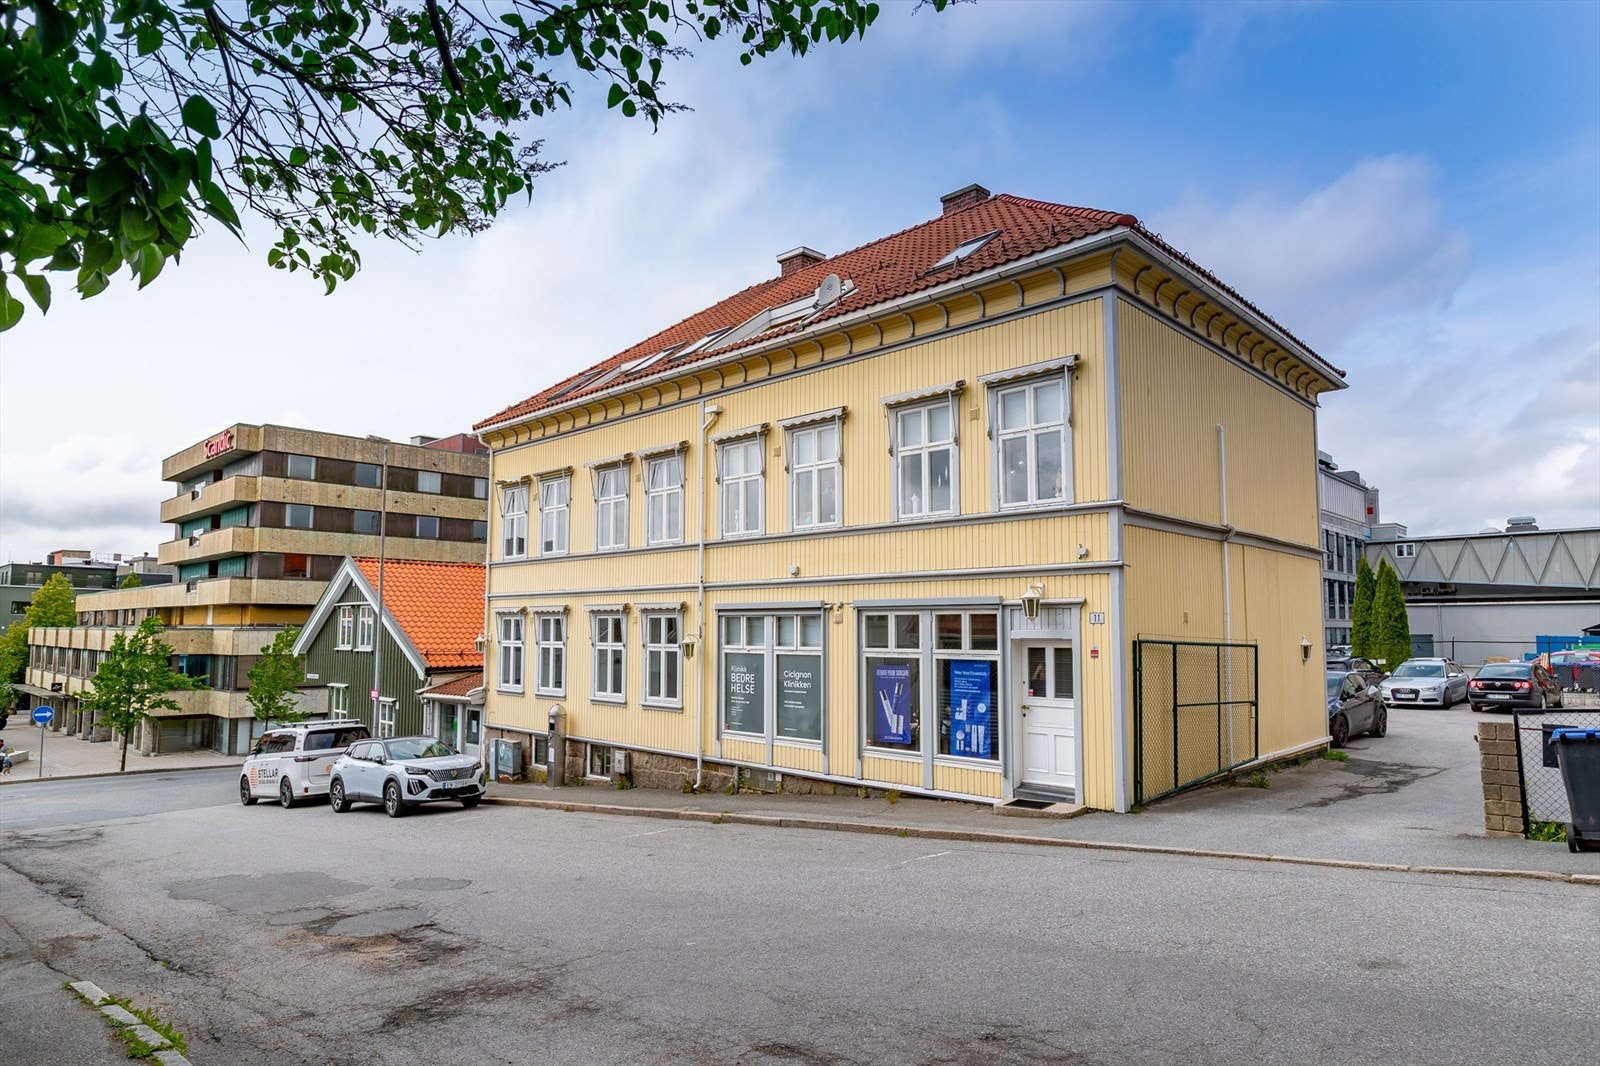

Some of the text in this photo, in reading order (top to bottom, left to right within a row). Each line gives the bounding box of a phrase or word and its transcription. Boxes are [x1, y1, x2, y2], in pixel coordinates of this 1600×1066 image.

[203, 429, 234, 459] Scandic
[1094, 614, 1101, 622] 11
[731, 673, 755, 684] BEDRE
[783, 670, 812, 681] Cicignon
[731, 683, 755, 695] HELSE
[783, 680, 812, 689] Klinikken
[258, 768, 279, 779] STELLAR
